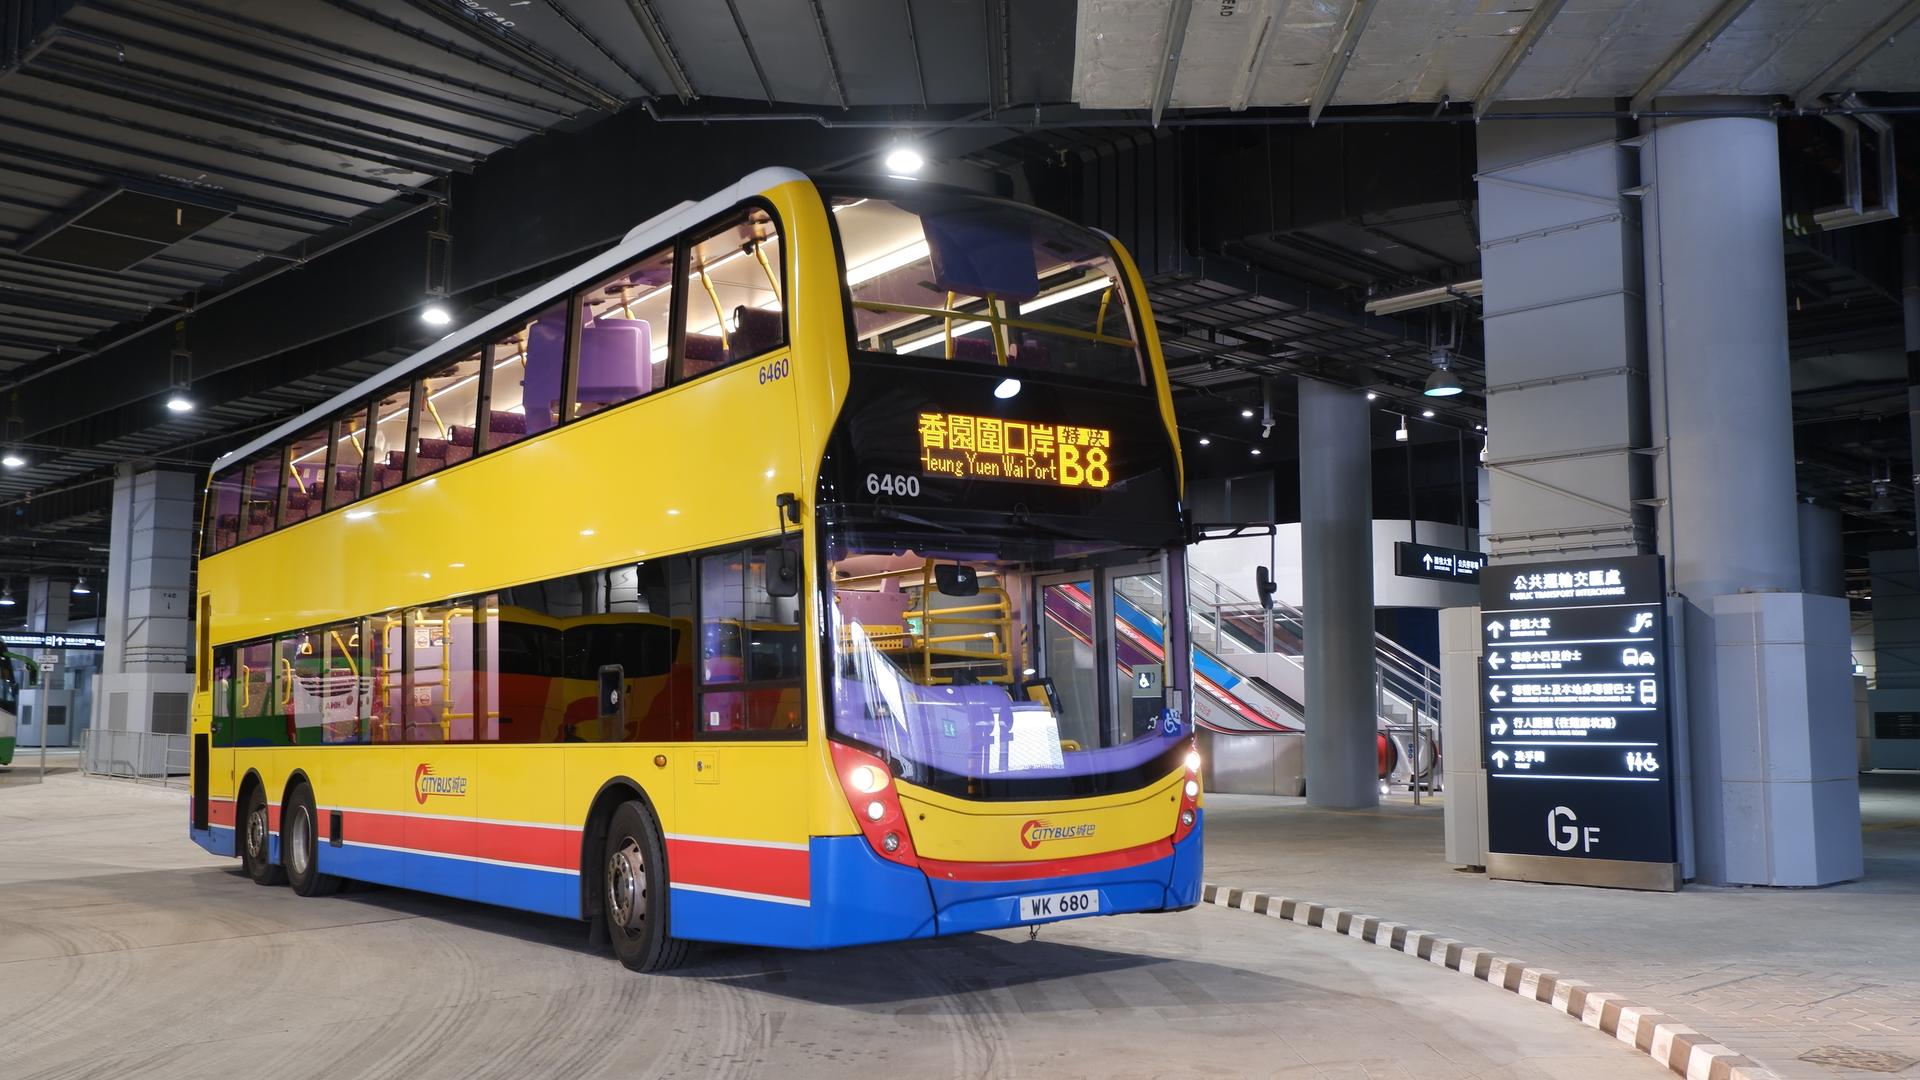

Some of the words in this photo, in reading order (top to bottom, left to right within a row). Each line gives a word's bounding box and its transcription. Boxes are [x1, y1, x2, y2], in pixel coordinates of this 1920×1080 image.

[758, 358, 789, 385] 6460
[918, 413, 1055, 458] 香園圍口岸
[965, 451, 1000, 474] Yuen
[1002, 455, 1024, 478] Wai
[1025, 456, 1058, 480] Port
[1060, 444, 1110, 487] B8
[866, 473, 920, 497] 6460
[1514, 569, 1621, 591] 公共運輸交匯處
[1510, 591, 1533, 600] PUBLIC
[1534, 589, 1574, 599] TRANSPORT
[1575, 586, 1625, 597] INTERCHANGE
[421, 776, 452, 793] CITYBUS
[1031, 825, 1076, 840] CITYBUS
[1076, 824, 1096, 838] 城巴
[1031, 898, 1052, 916] WK
[1059, 893, 1089, 912] 680
